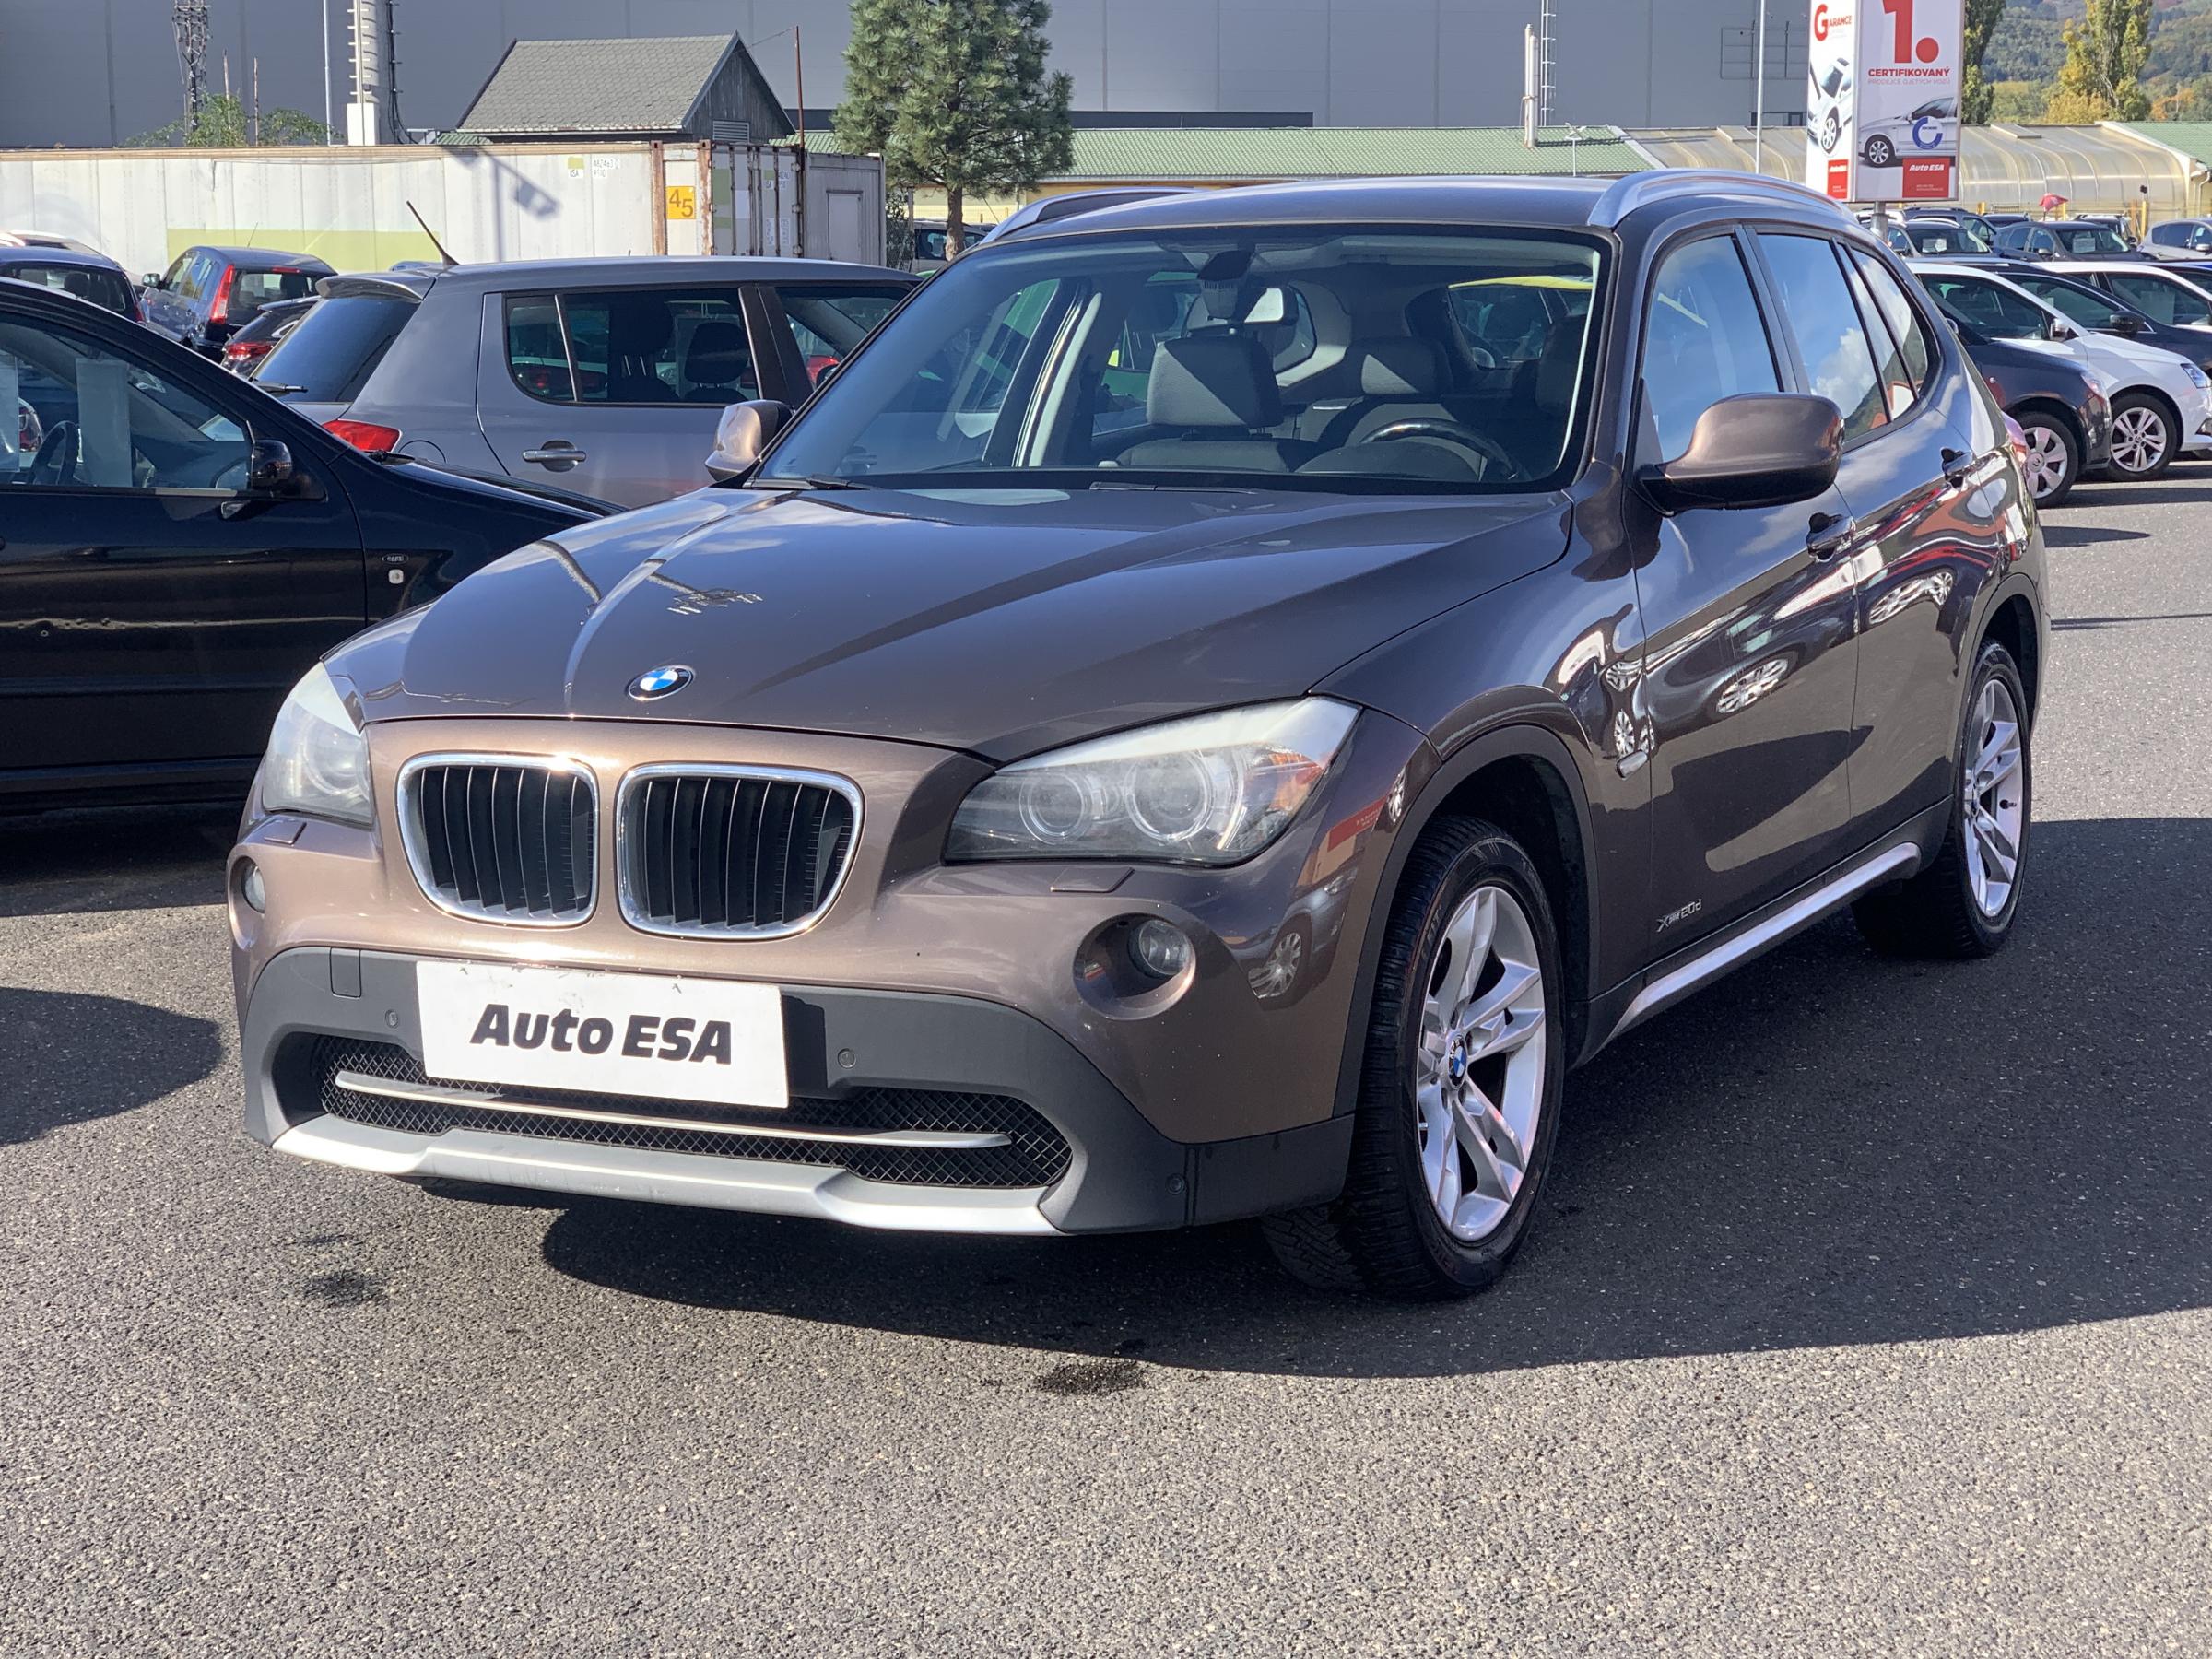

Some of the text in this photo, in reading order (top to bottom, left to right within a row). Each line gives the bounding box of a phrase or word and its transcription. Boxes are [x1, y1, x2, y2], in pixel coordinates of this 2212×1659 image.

[1868, 66, 1950, 76] CERTIFIKOVANÝ
[669, 188, 694, 218] 45
[469, 1004, 732, 1065] Auto ESA
